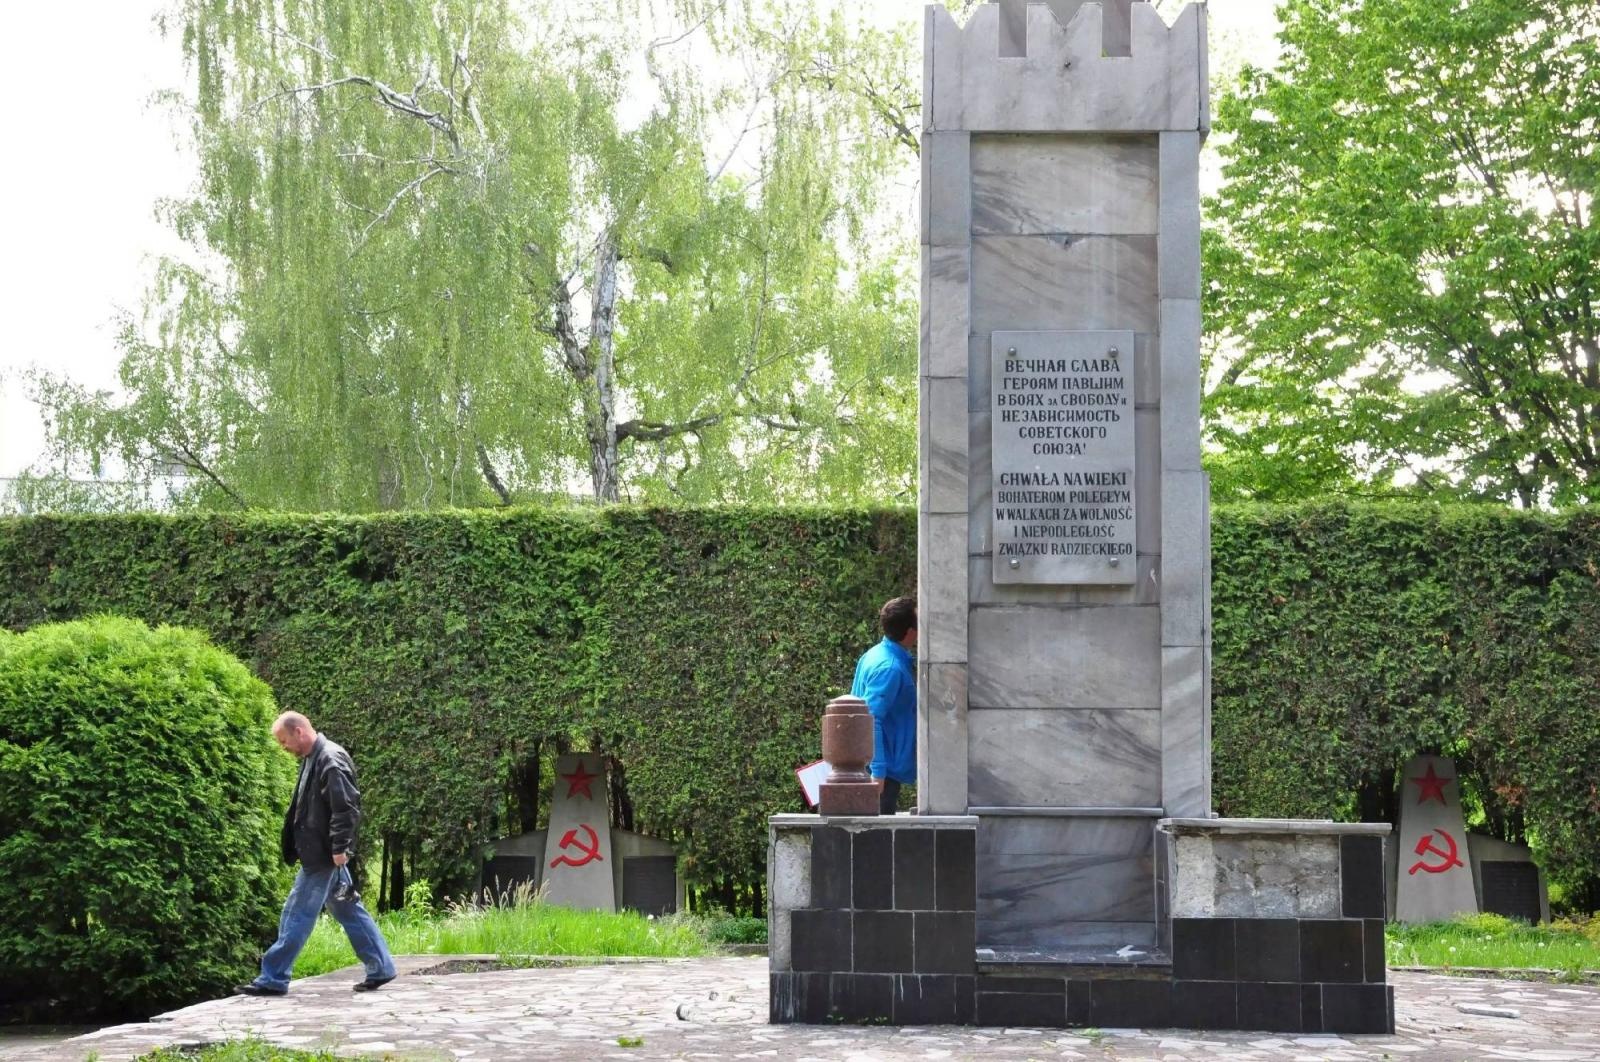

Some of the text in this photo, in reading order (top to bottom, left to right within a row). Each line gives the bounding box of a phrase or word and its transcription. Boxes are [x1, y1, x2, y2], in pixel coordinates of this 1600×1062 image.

[1005, 360, 1120, 372] ВЕЧНАЯ СЛАВА
[1004, 378, 1124, 389] ГЕРОЯМ ПАВШИМ
[998, 394, 1006, 406] В
[1009, 394, 1044, 406] БОЯХ
[1061, 394, 1120, 406] СВОБОДУ
[1002, 410, 1120, 422] НЕЗАВИСИМОСТЬ
[1019, 427, 1106, 438] СОВЕТСКОГО
[1033, 443, 1086, 455] СОЮЗА!
[1000, 472, 1059, 486] CHWAŁA
[998, 490, 1130, 503] BOHATEROM POLEGŁYM
[996, 506, 1132, 520] W WALKACH ZA WOLNOŚĆ
[1022, 524, 1114, 538] NIEPODLEGŁOŚĆ
[999, 543, 1132, 556] ZWIĄZKU RADZIECKIEGO
